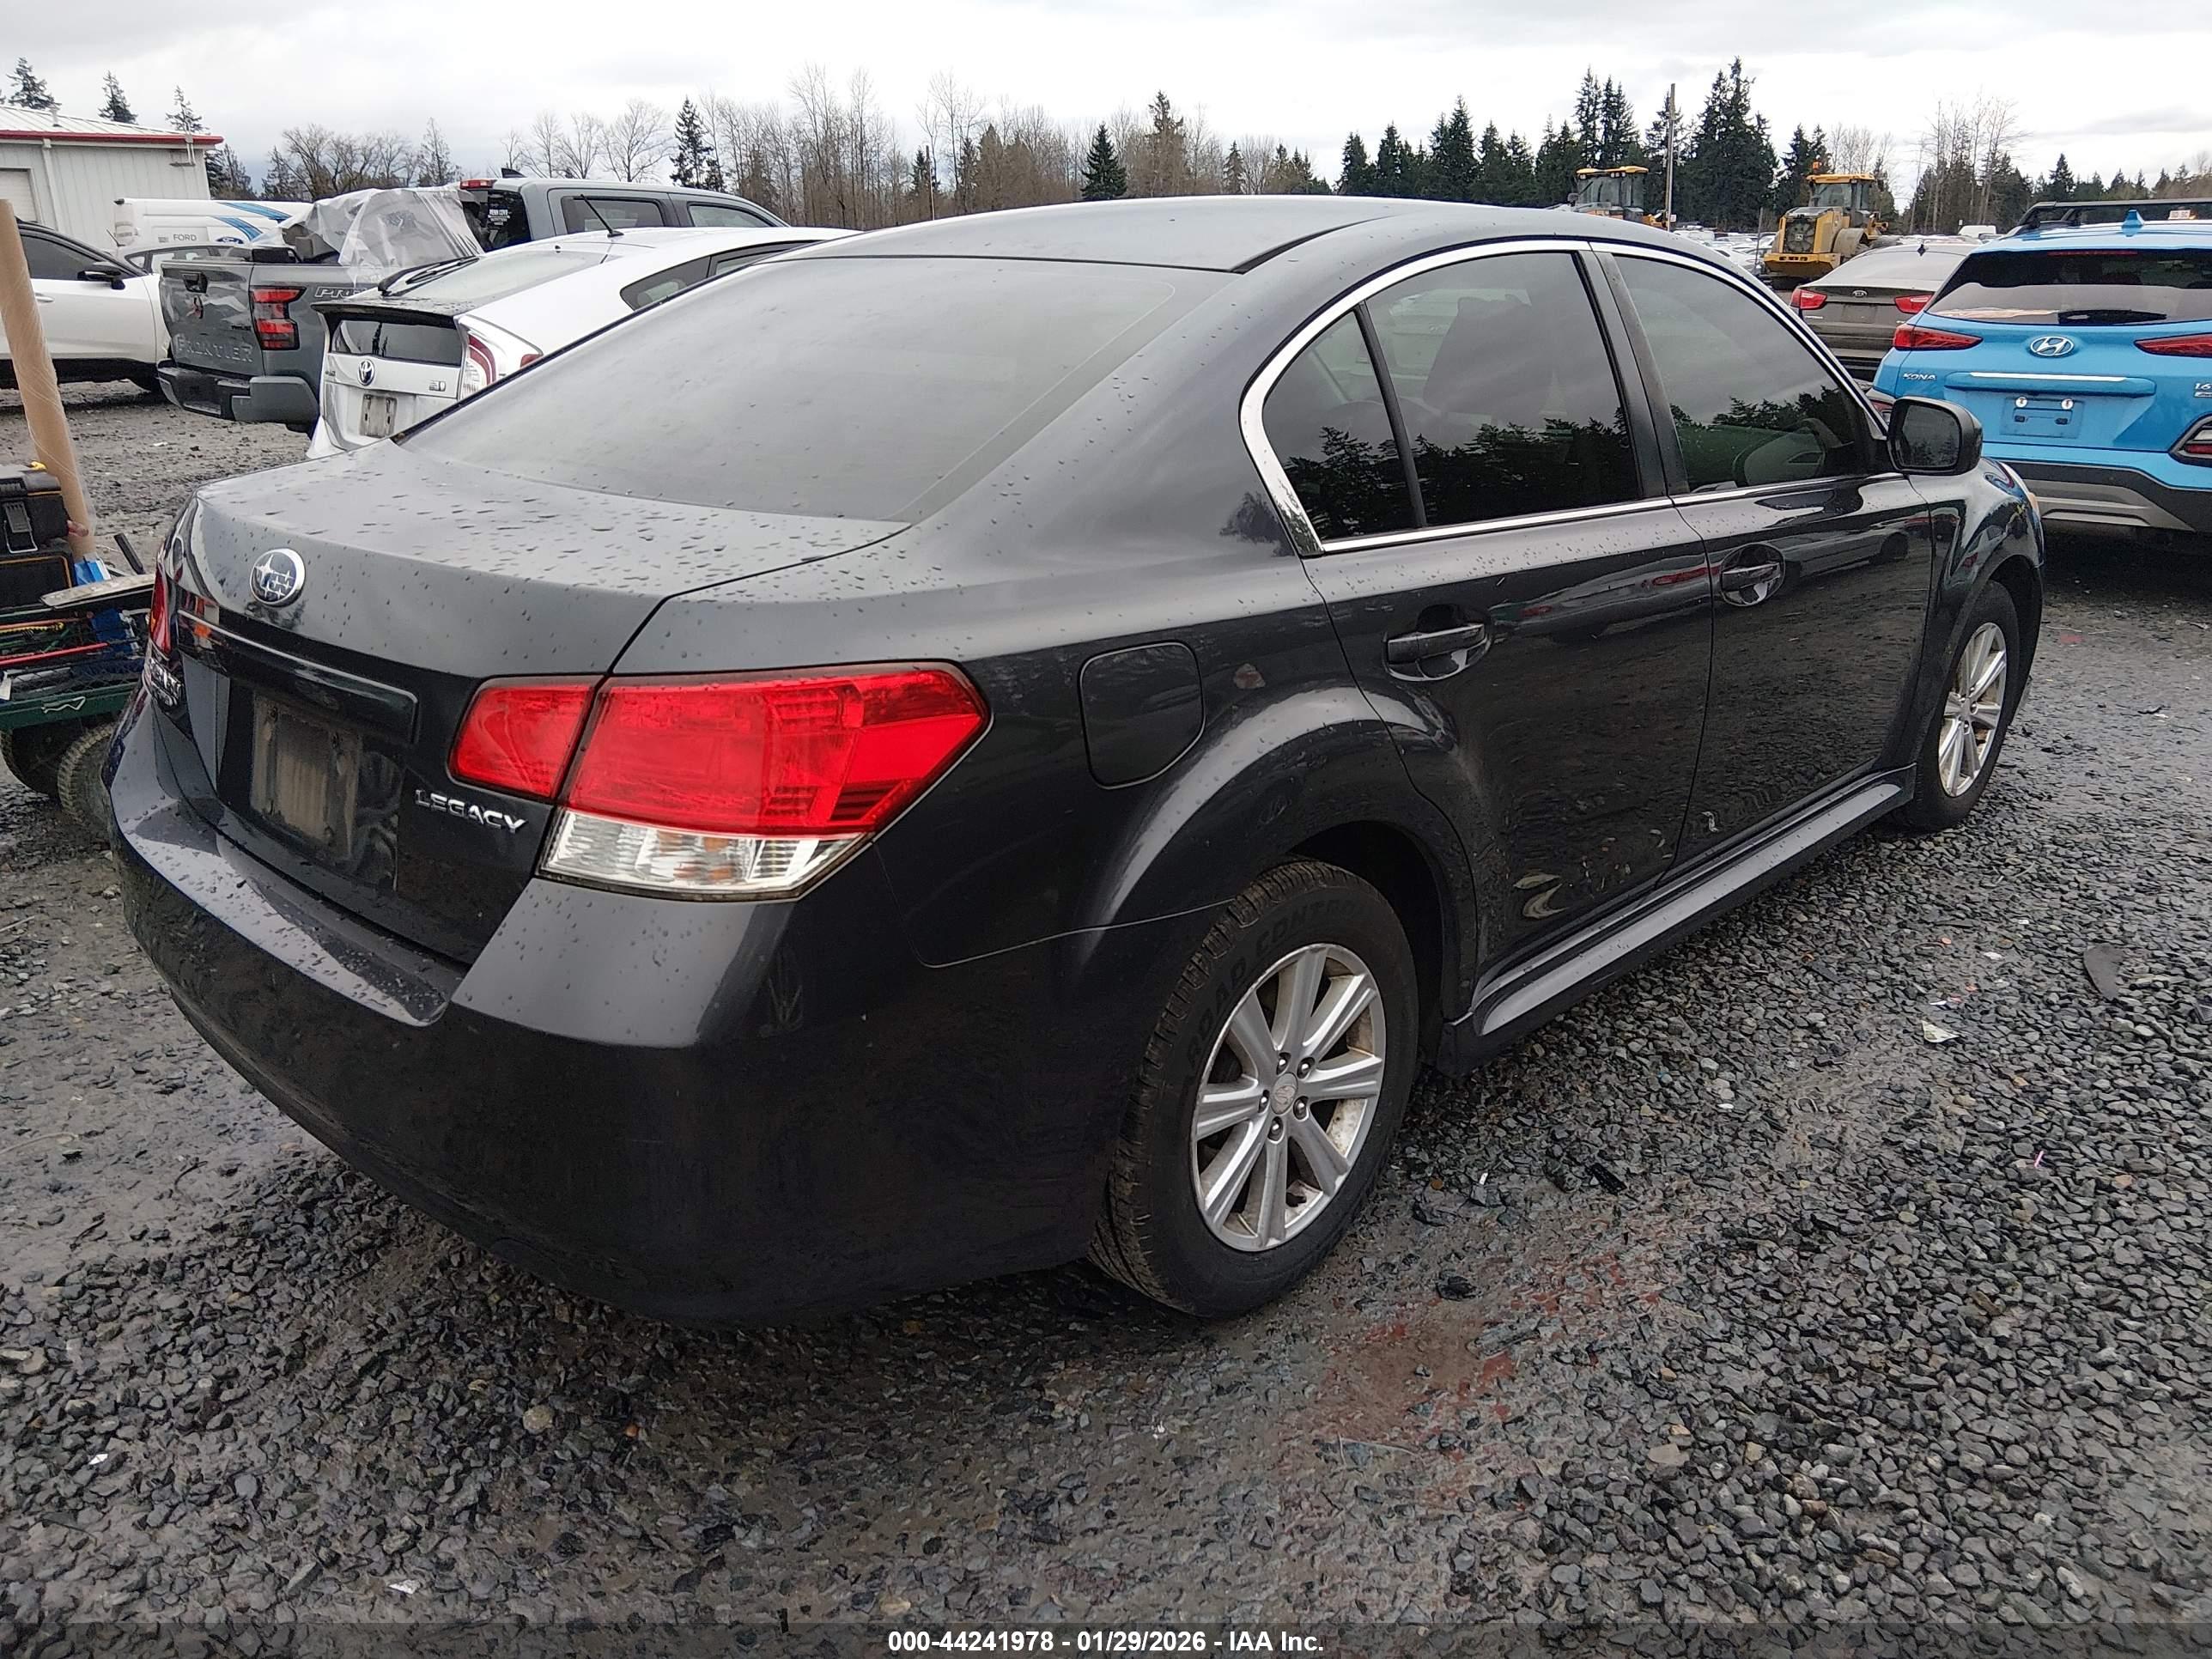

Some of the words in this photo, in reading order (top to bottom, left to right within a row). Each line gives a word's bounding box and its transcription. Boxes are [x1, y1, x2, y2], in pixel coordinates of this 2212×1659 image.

[174, 333, 253, 362] FRONTIER
[415, 789, 528, 834] LEGACY
[1188, 957, 1246, 1069] ROAD
[1255, 899, 1362, 957] CONTRO
